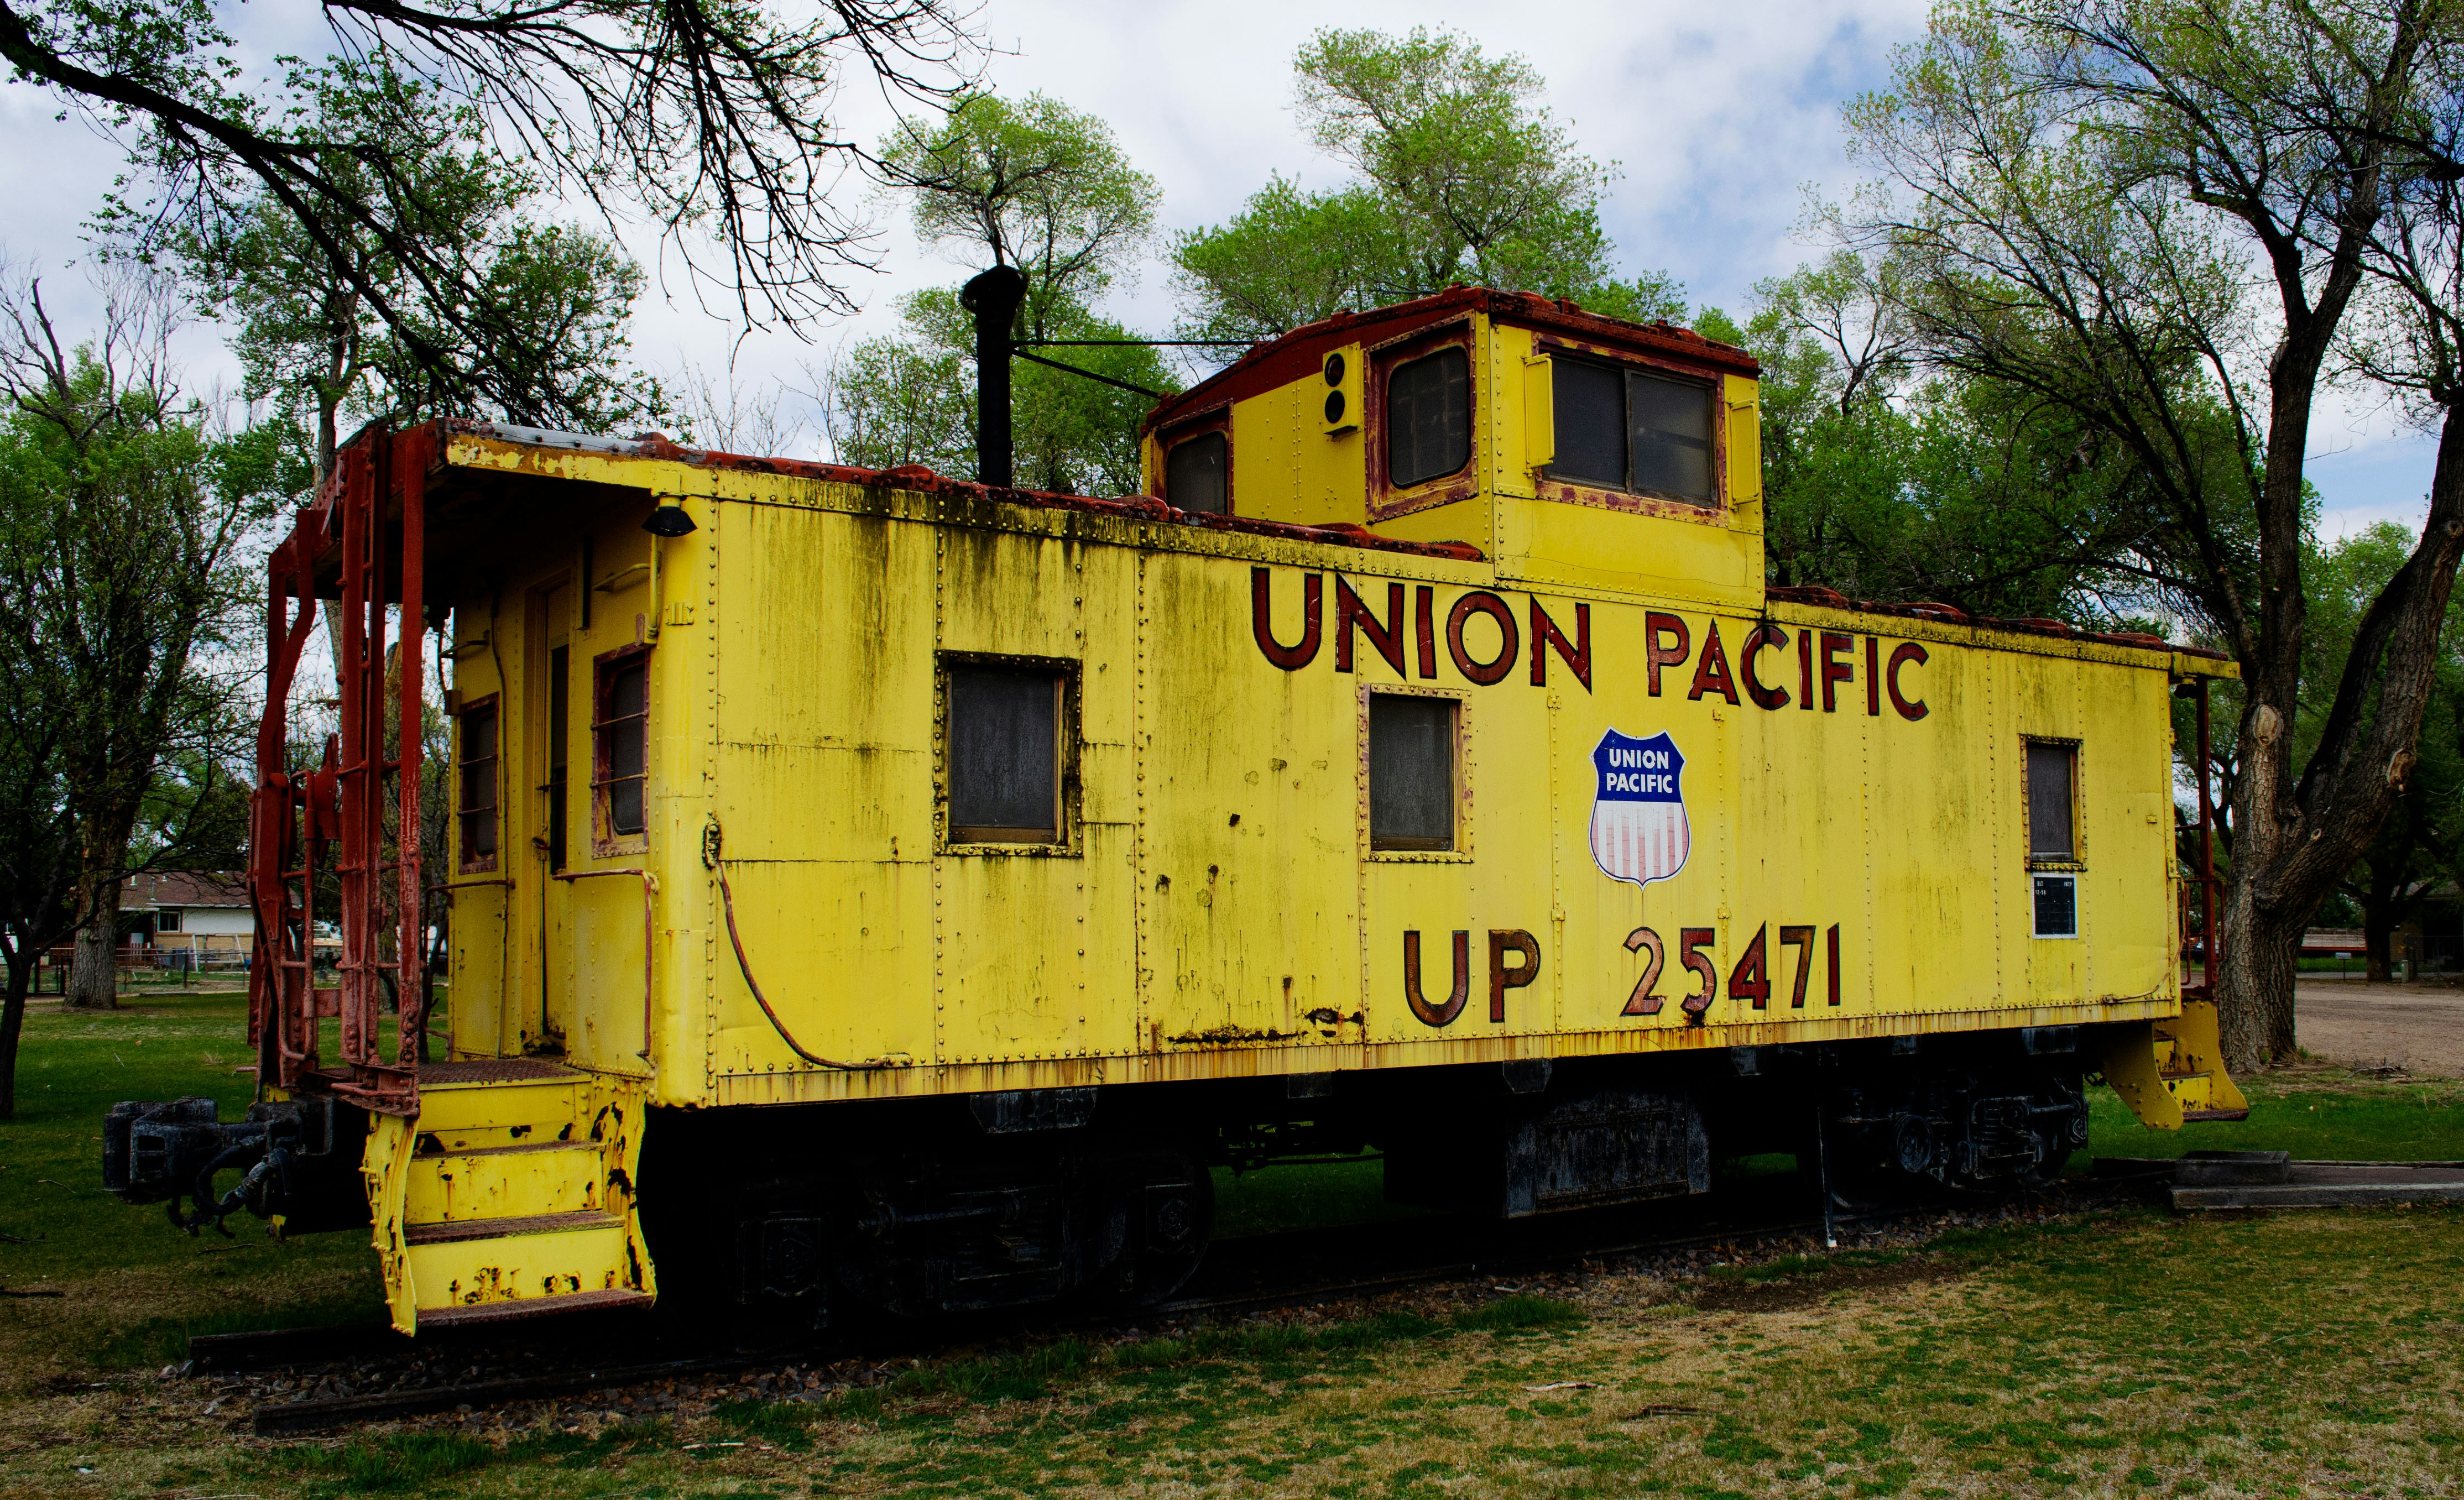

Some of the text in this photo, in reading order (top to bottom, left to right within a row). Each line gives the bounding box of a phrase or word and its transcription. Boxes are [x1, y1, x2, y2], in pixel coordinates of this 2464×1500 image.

[1250, 566, 1930, 722] UNION PACIFIC
[1606, 773, 1673, 793] PACIFIC
[1609, 749, 1669, 769] UNION
[1403, 920, 1841, 1028] UP 25471
